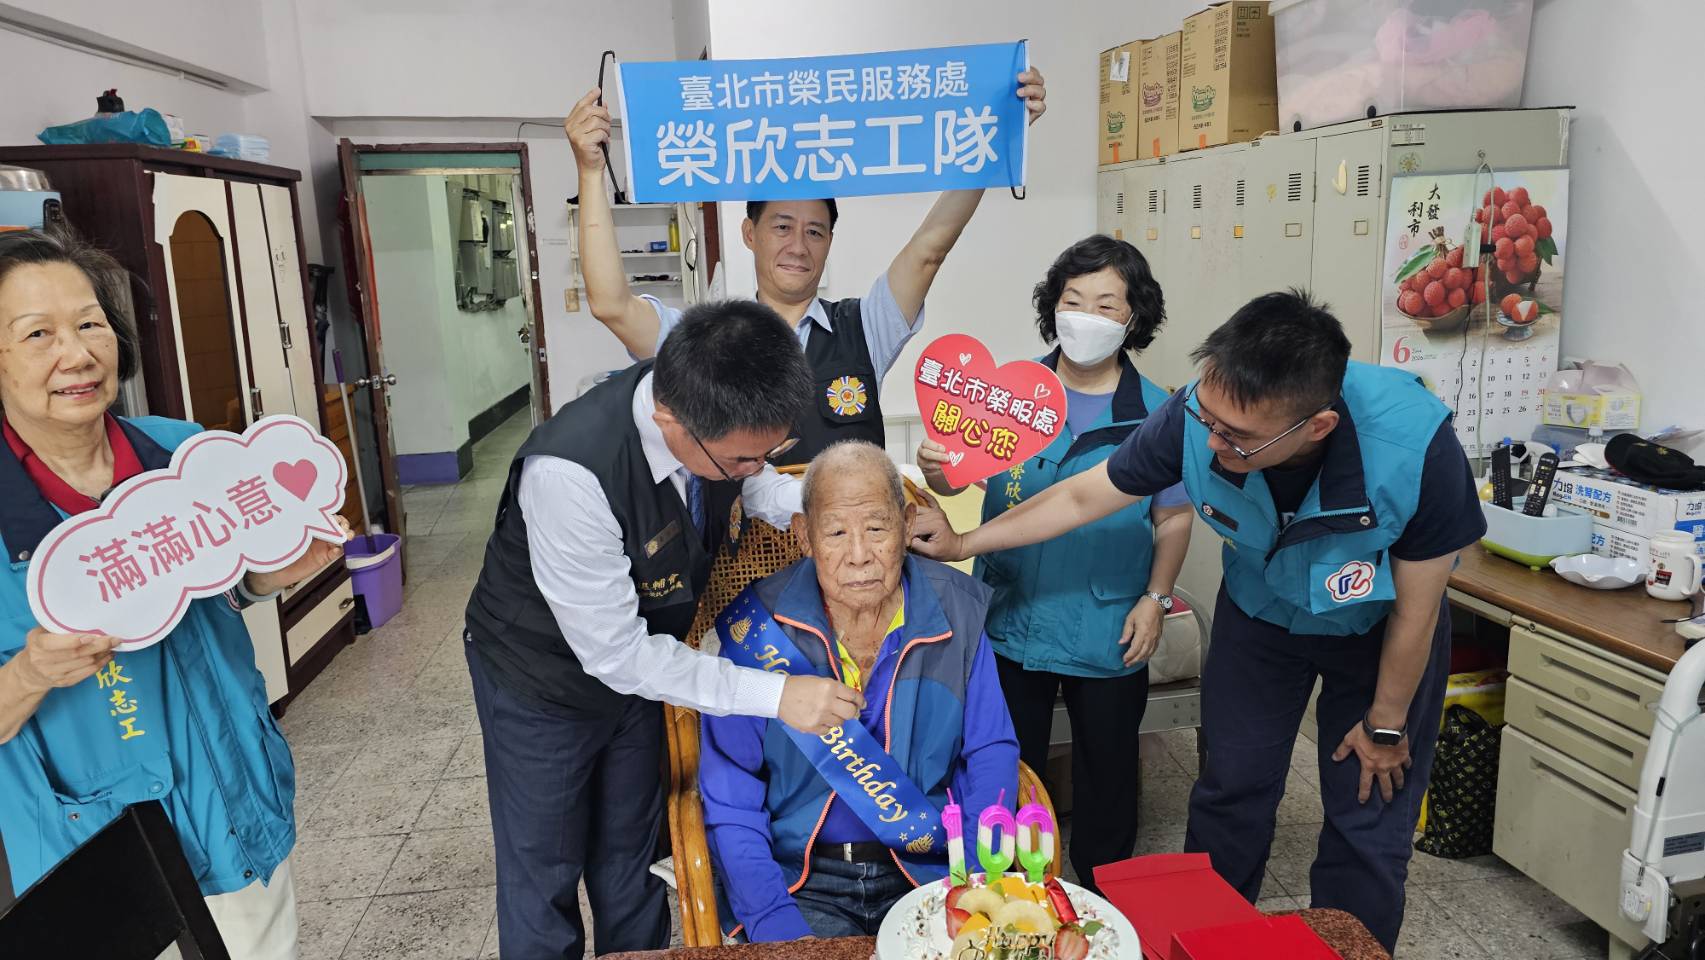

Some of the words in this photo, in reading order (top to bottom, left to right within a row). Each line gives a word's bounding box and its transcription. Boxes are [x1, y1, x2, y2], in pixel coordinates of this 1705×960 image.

[679, 61, 968, 111] 臺北市榮民服務處
[656, 105, 998, 187] 榮欣志工隊
[1407, 201, 1423, 238] 利市
[1426, 182, 1440, 220] 大發
[1393, 336, 1410, 364] 6
[918, 356, 1059, 436] 臺北市榮服處
[931, 400, 1020, 461] 關心您
[78, 475, 282, 603] 滿滿心意
[819, 725, 909, 823] Birthday
